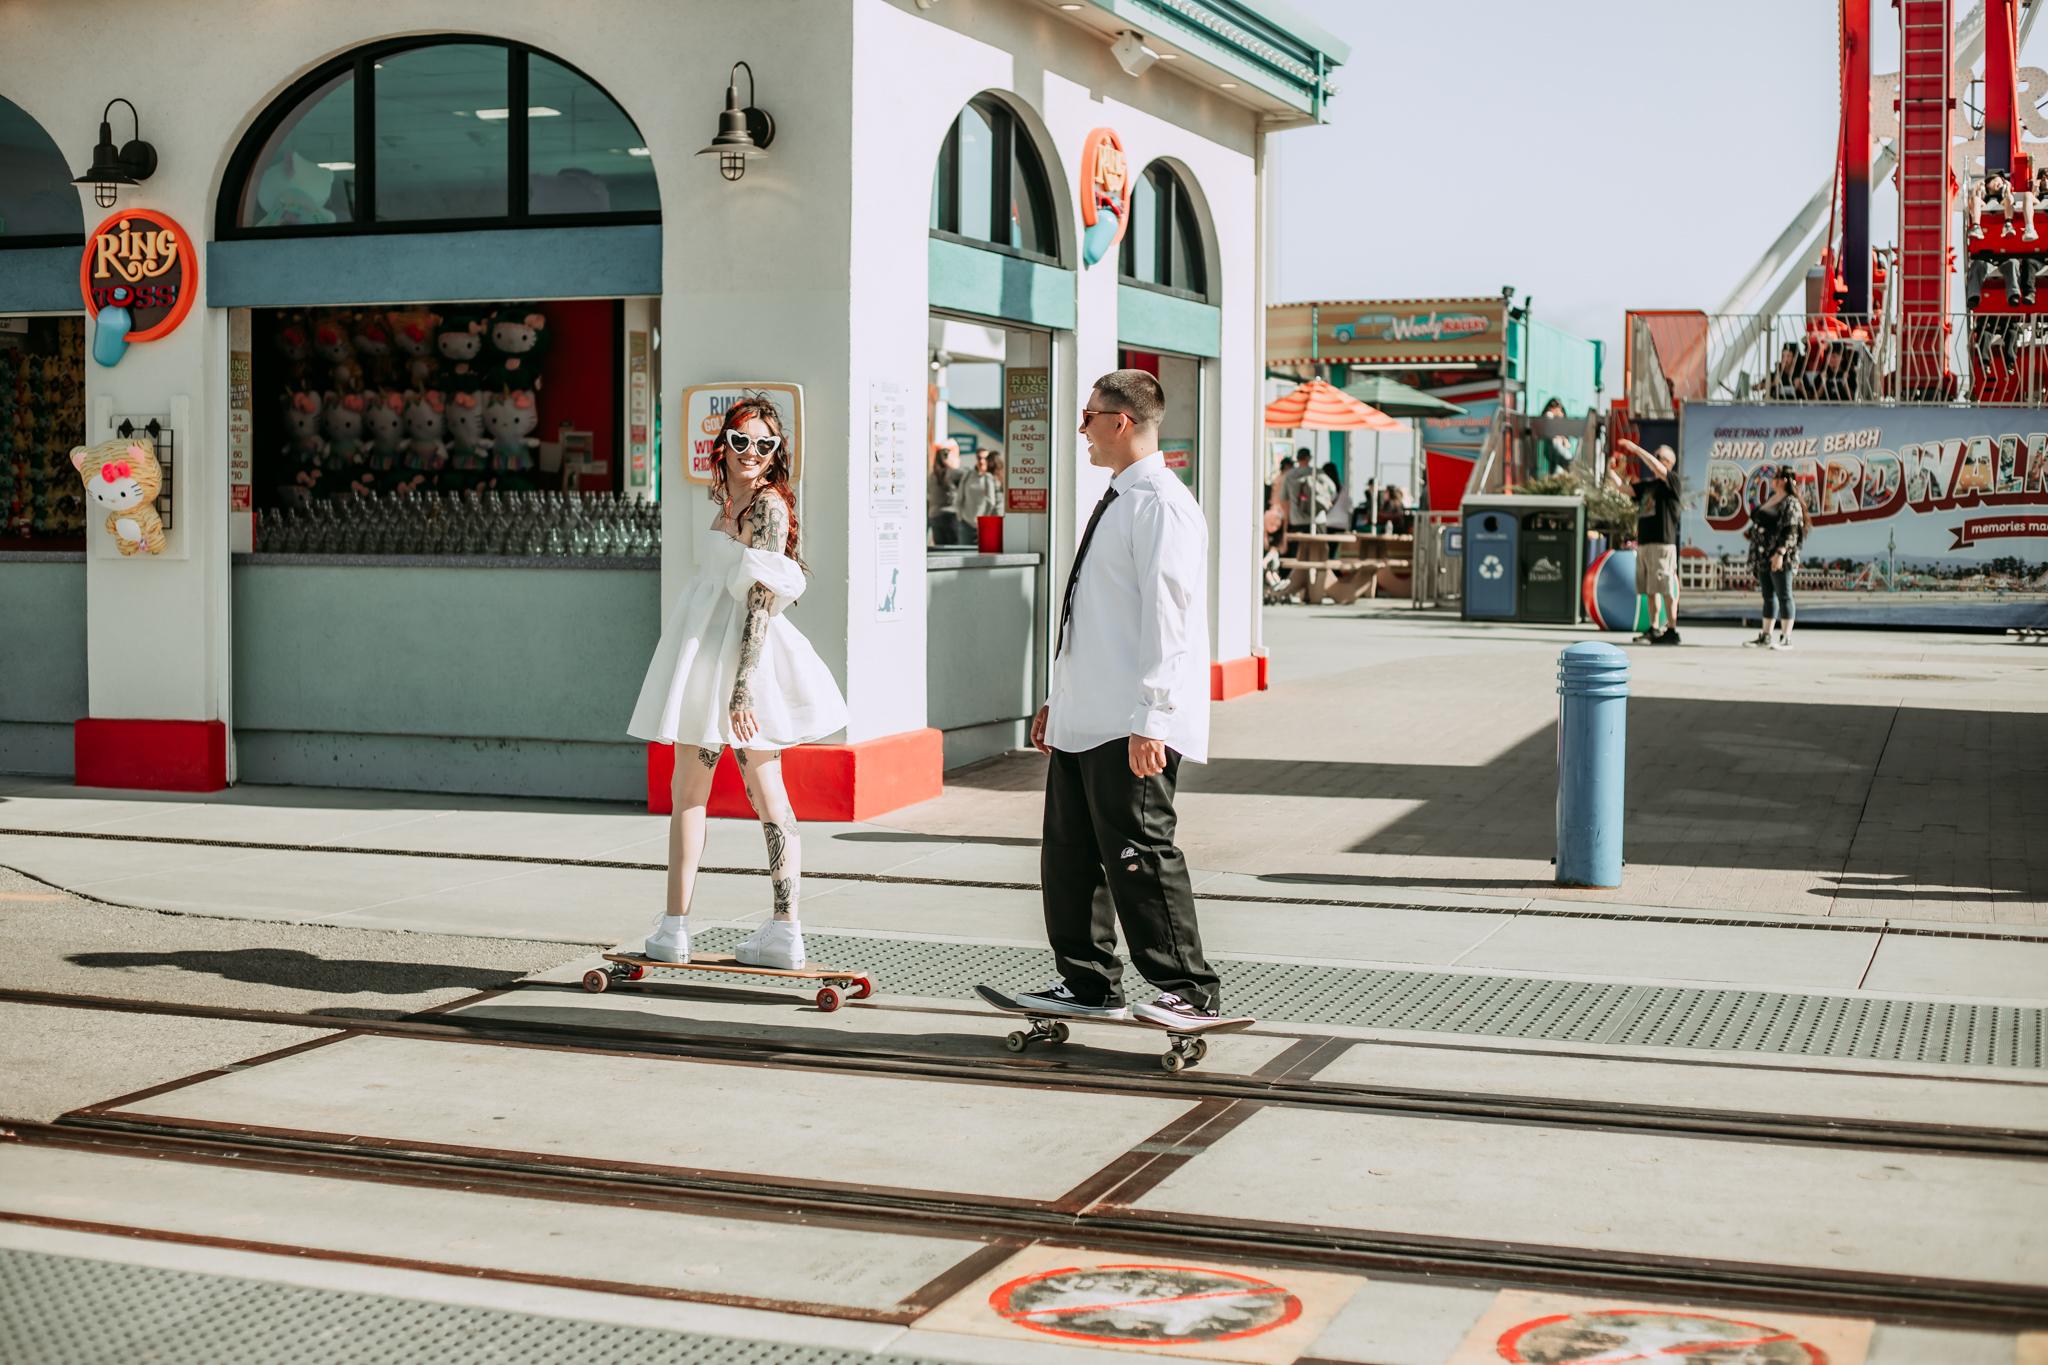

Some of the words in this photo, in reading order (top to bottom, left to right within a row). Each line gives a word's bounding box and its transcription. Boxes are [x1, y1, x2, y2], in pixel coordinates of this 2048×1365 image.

[92, 284, 176, 308] TOSS
[1011, 375, 1048, 385] RING
[1010, 385, 1048, 394] TOSS
[1012, 433, 1046, 441] RINGS
[1714, 427, 1771, 439] GREETINGS
[1773, 425, 1804, 437] FROM
[1710, 440, 1767, 460] SANTA
[1770, 438, 1820, 460] CRUZ
[1823, 427, 1882, 453] BEACH
[1971, 520, 2026, 535] memories
[2028, 521, 2048, 532] ma
